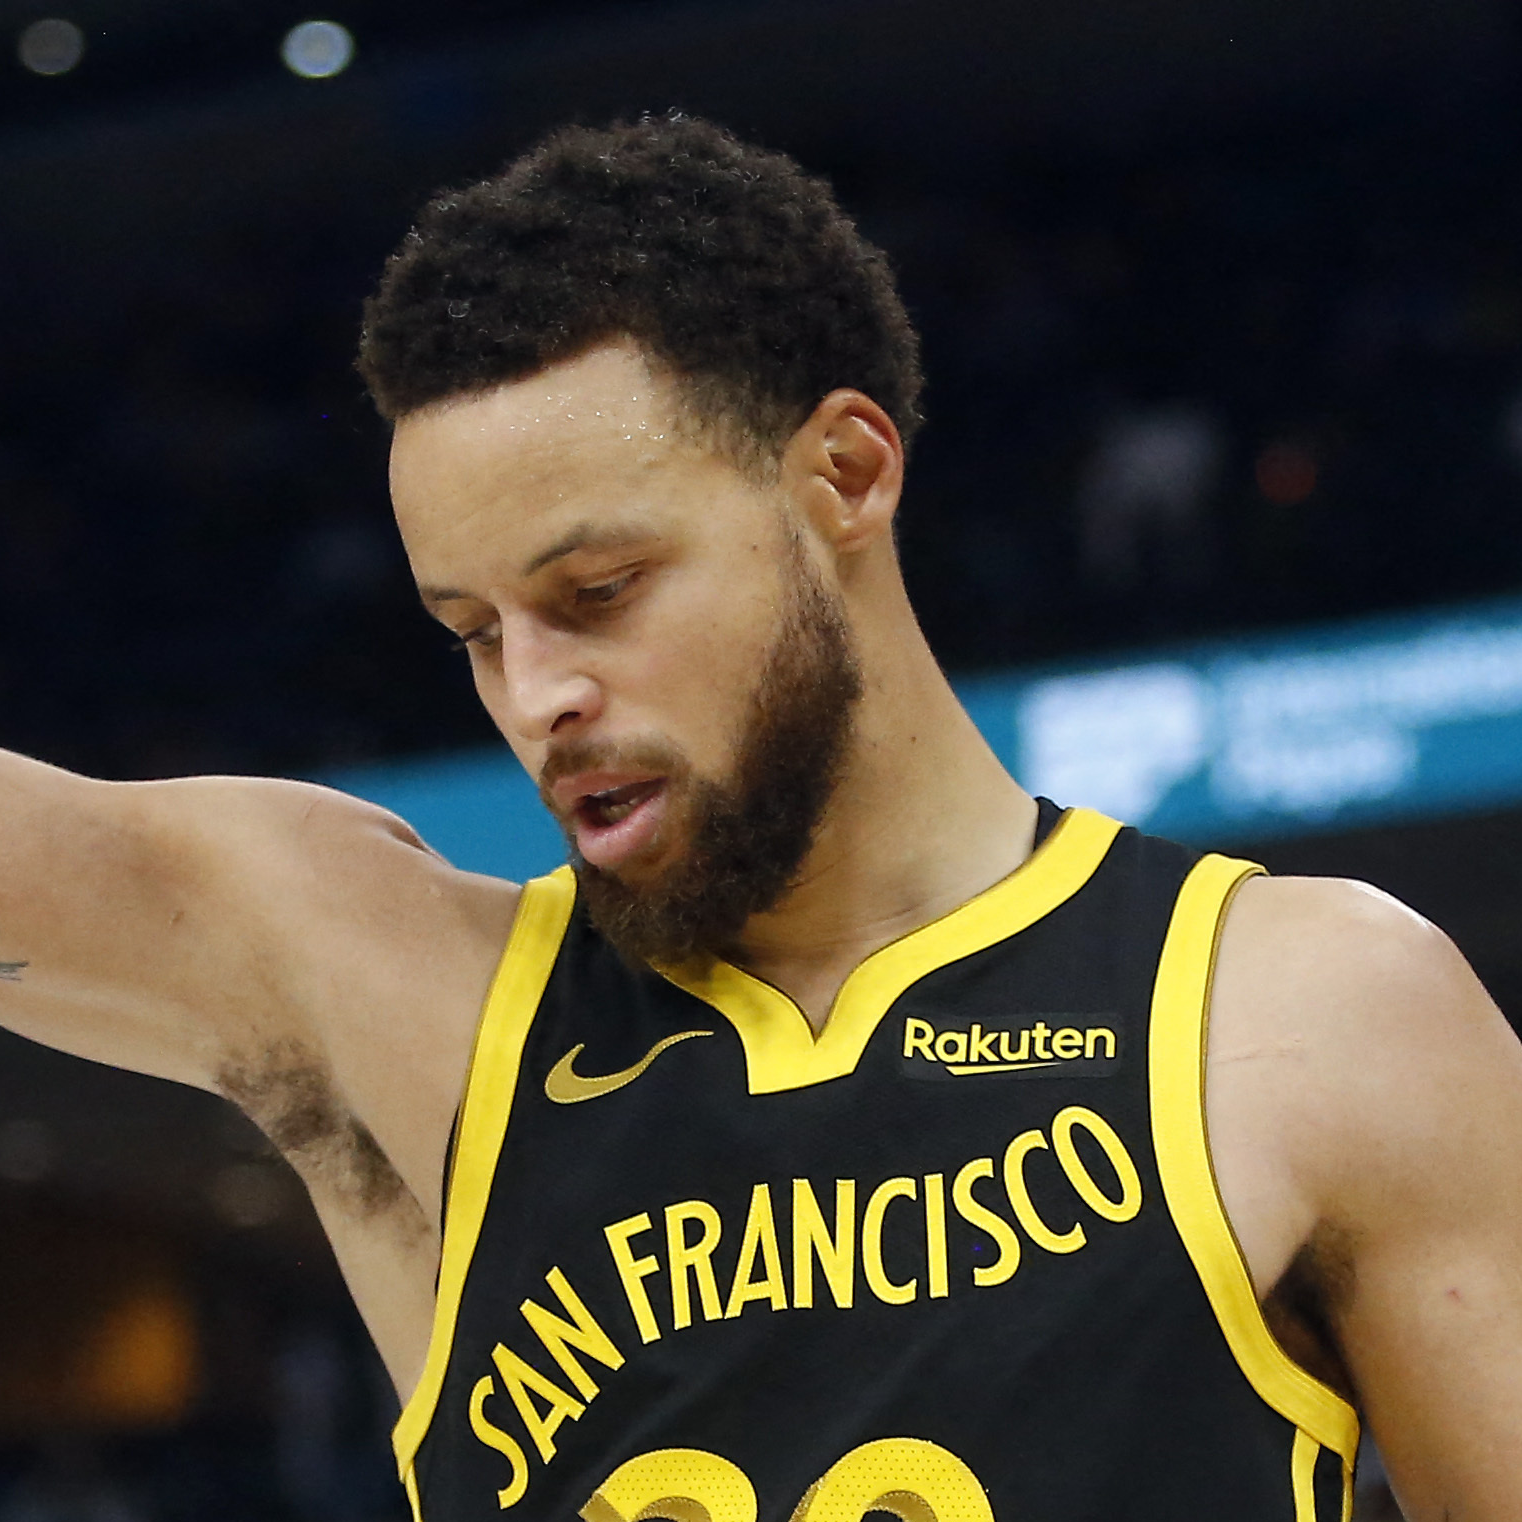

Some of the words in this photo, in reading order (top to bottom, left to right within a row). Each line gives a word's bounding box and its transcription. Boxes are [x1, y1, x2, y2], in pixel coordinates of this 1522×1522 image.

[903, 1016, 1117, 1064] Rakuten
[468, 1266, 626, 1510] SAN
[603, 1105, 1143, 1345] FRANCISCO
